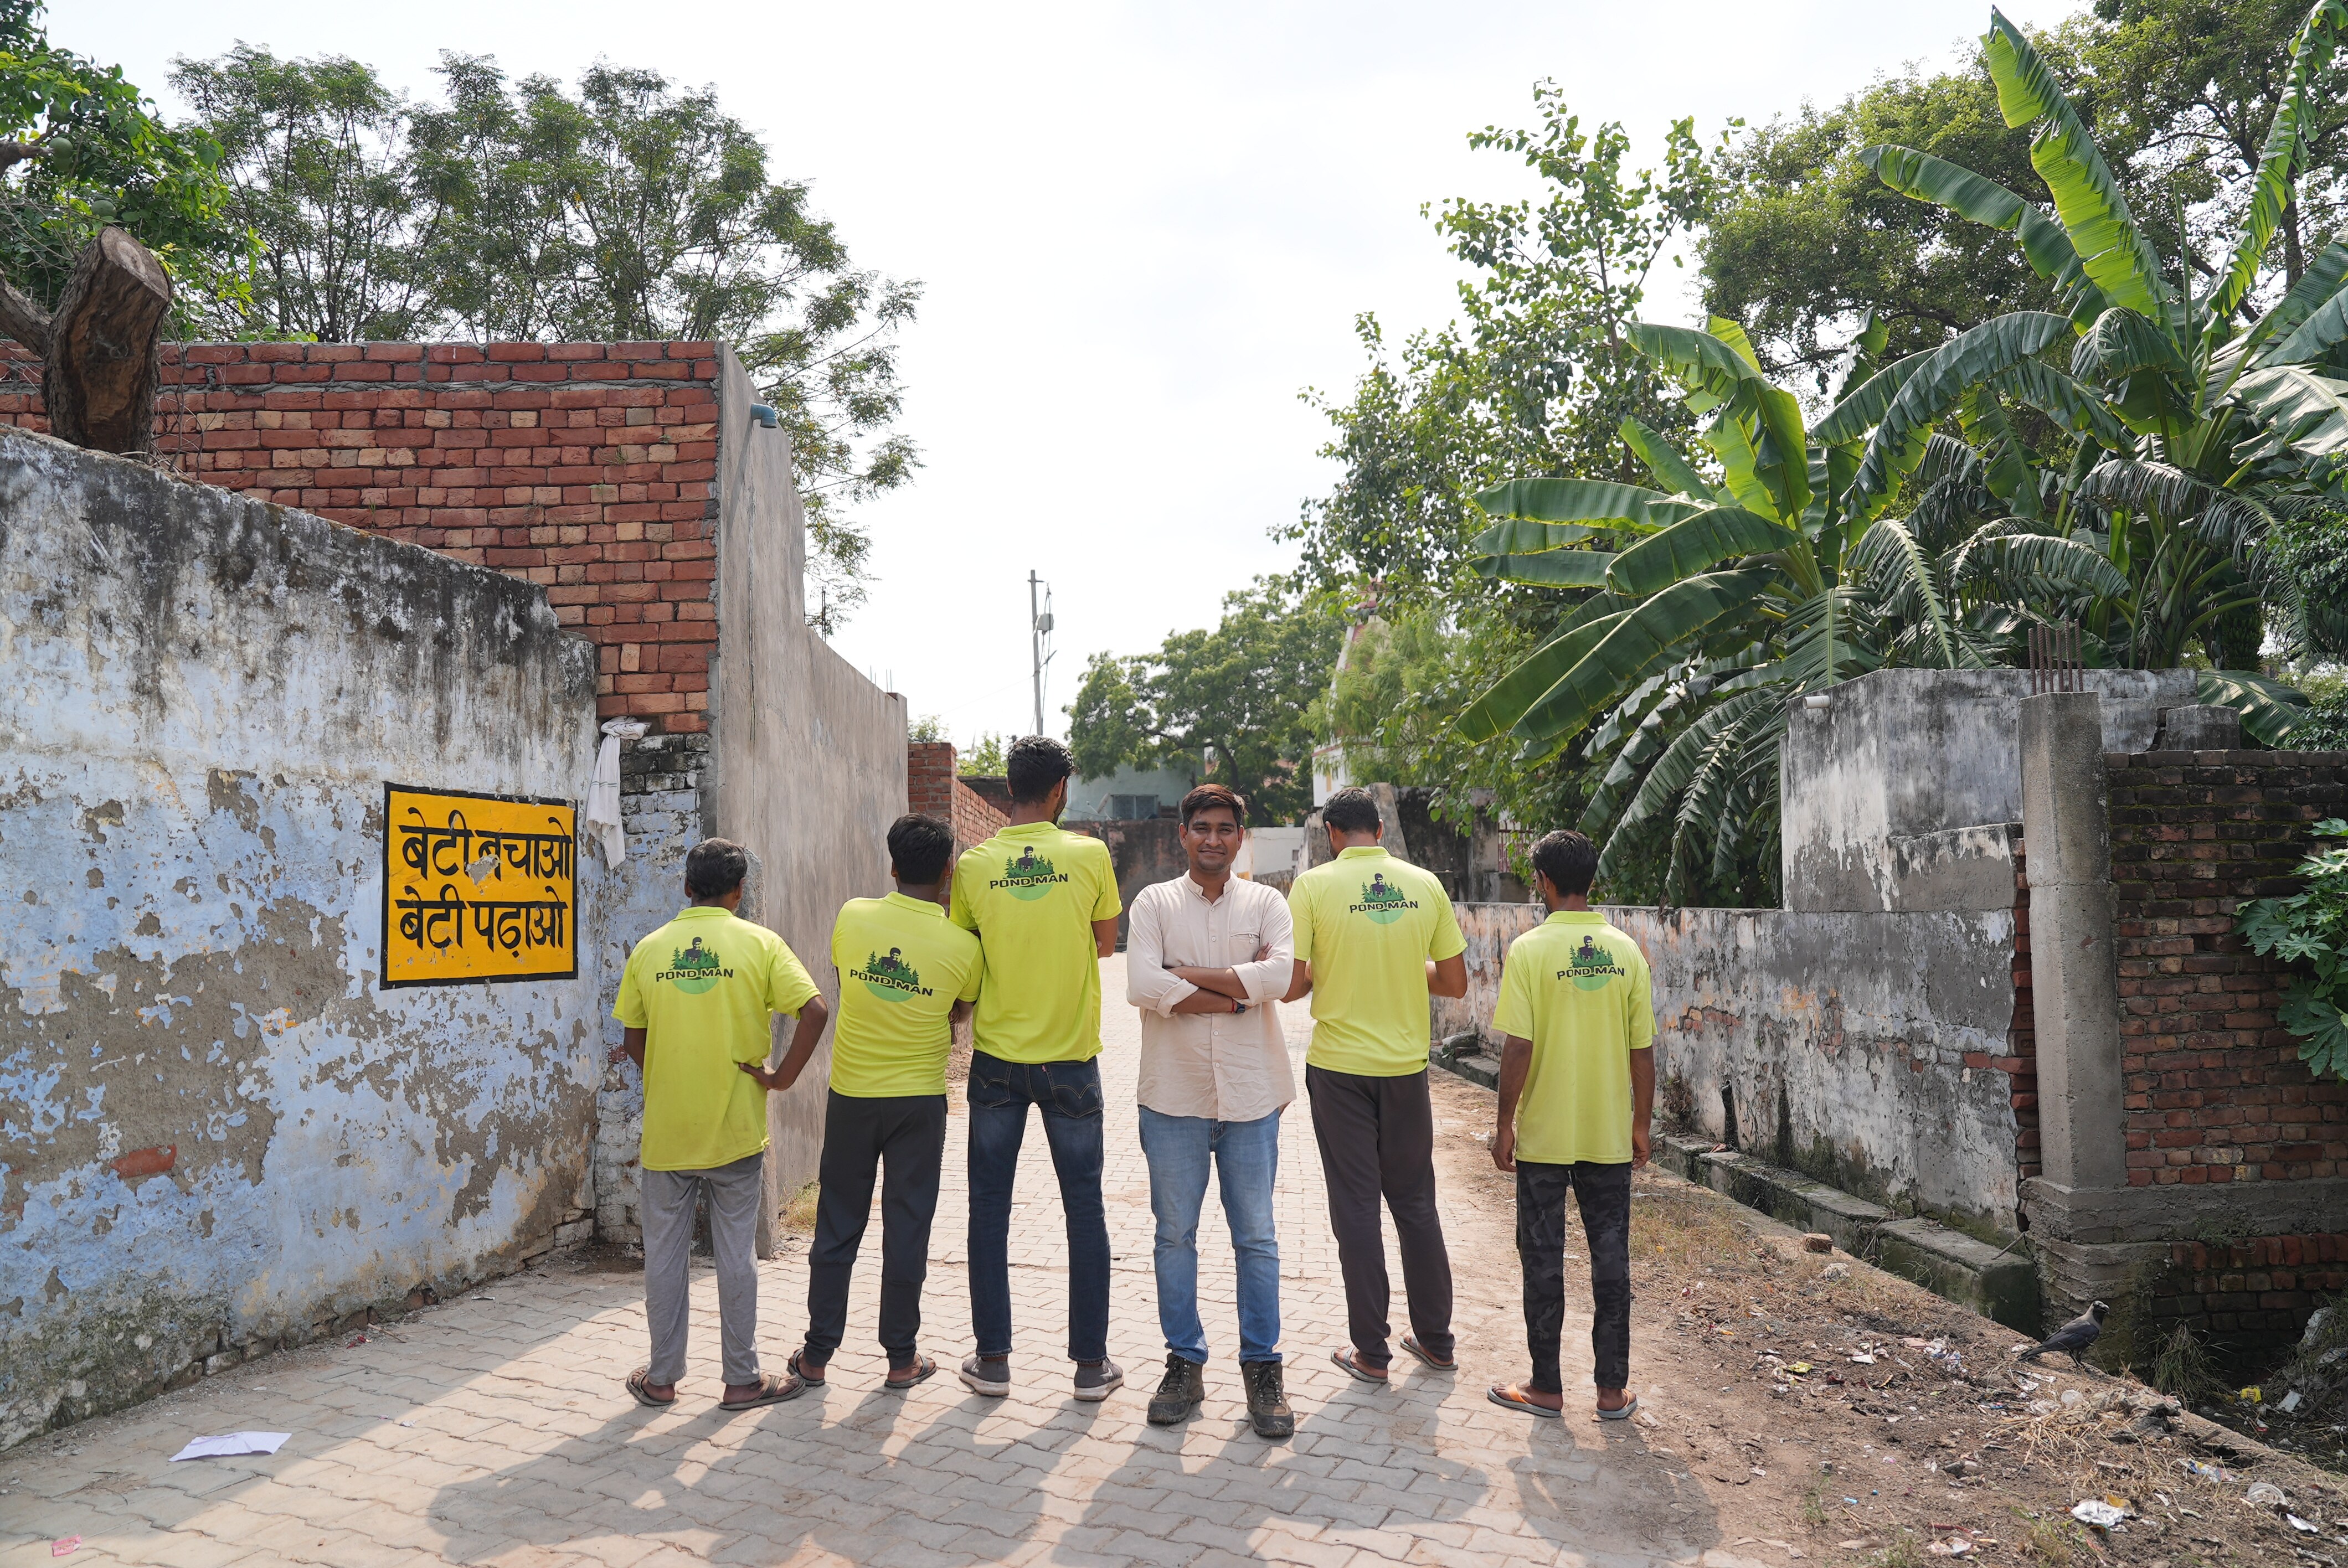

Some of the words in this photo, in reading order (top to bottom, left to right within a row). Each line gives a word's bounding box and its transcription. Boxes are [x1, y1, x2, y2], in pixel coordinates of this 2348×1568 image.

[399, 807, 475, 880] बेटी
[475, 817, 573, 881] बचाओ
[990, 878, 1030, 889] POND
[1036, 873, 1068, 884] MAN
[1350, 903, 1384, 913] POND
[395, 884, 467, 951] बेटी
[467, 885, 568, 958] पढ़ाओ
[656, 971, 697, 982] POND
[702, 968, 733, 978] MAN
[1557, 968, 1590, 980] POND
[1595, 967, 1625, 976] MAN
[850, 969, 891, 984] POND
[896, 981, 933, 996] MAN
